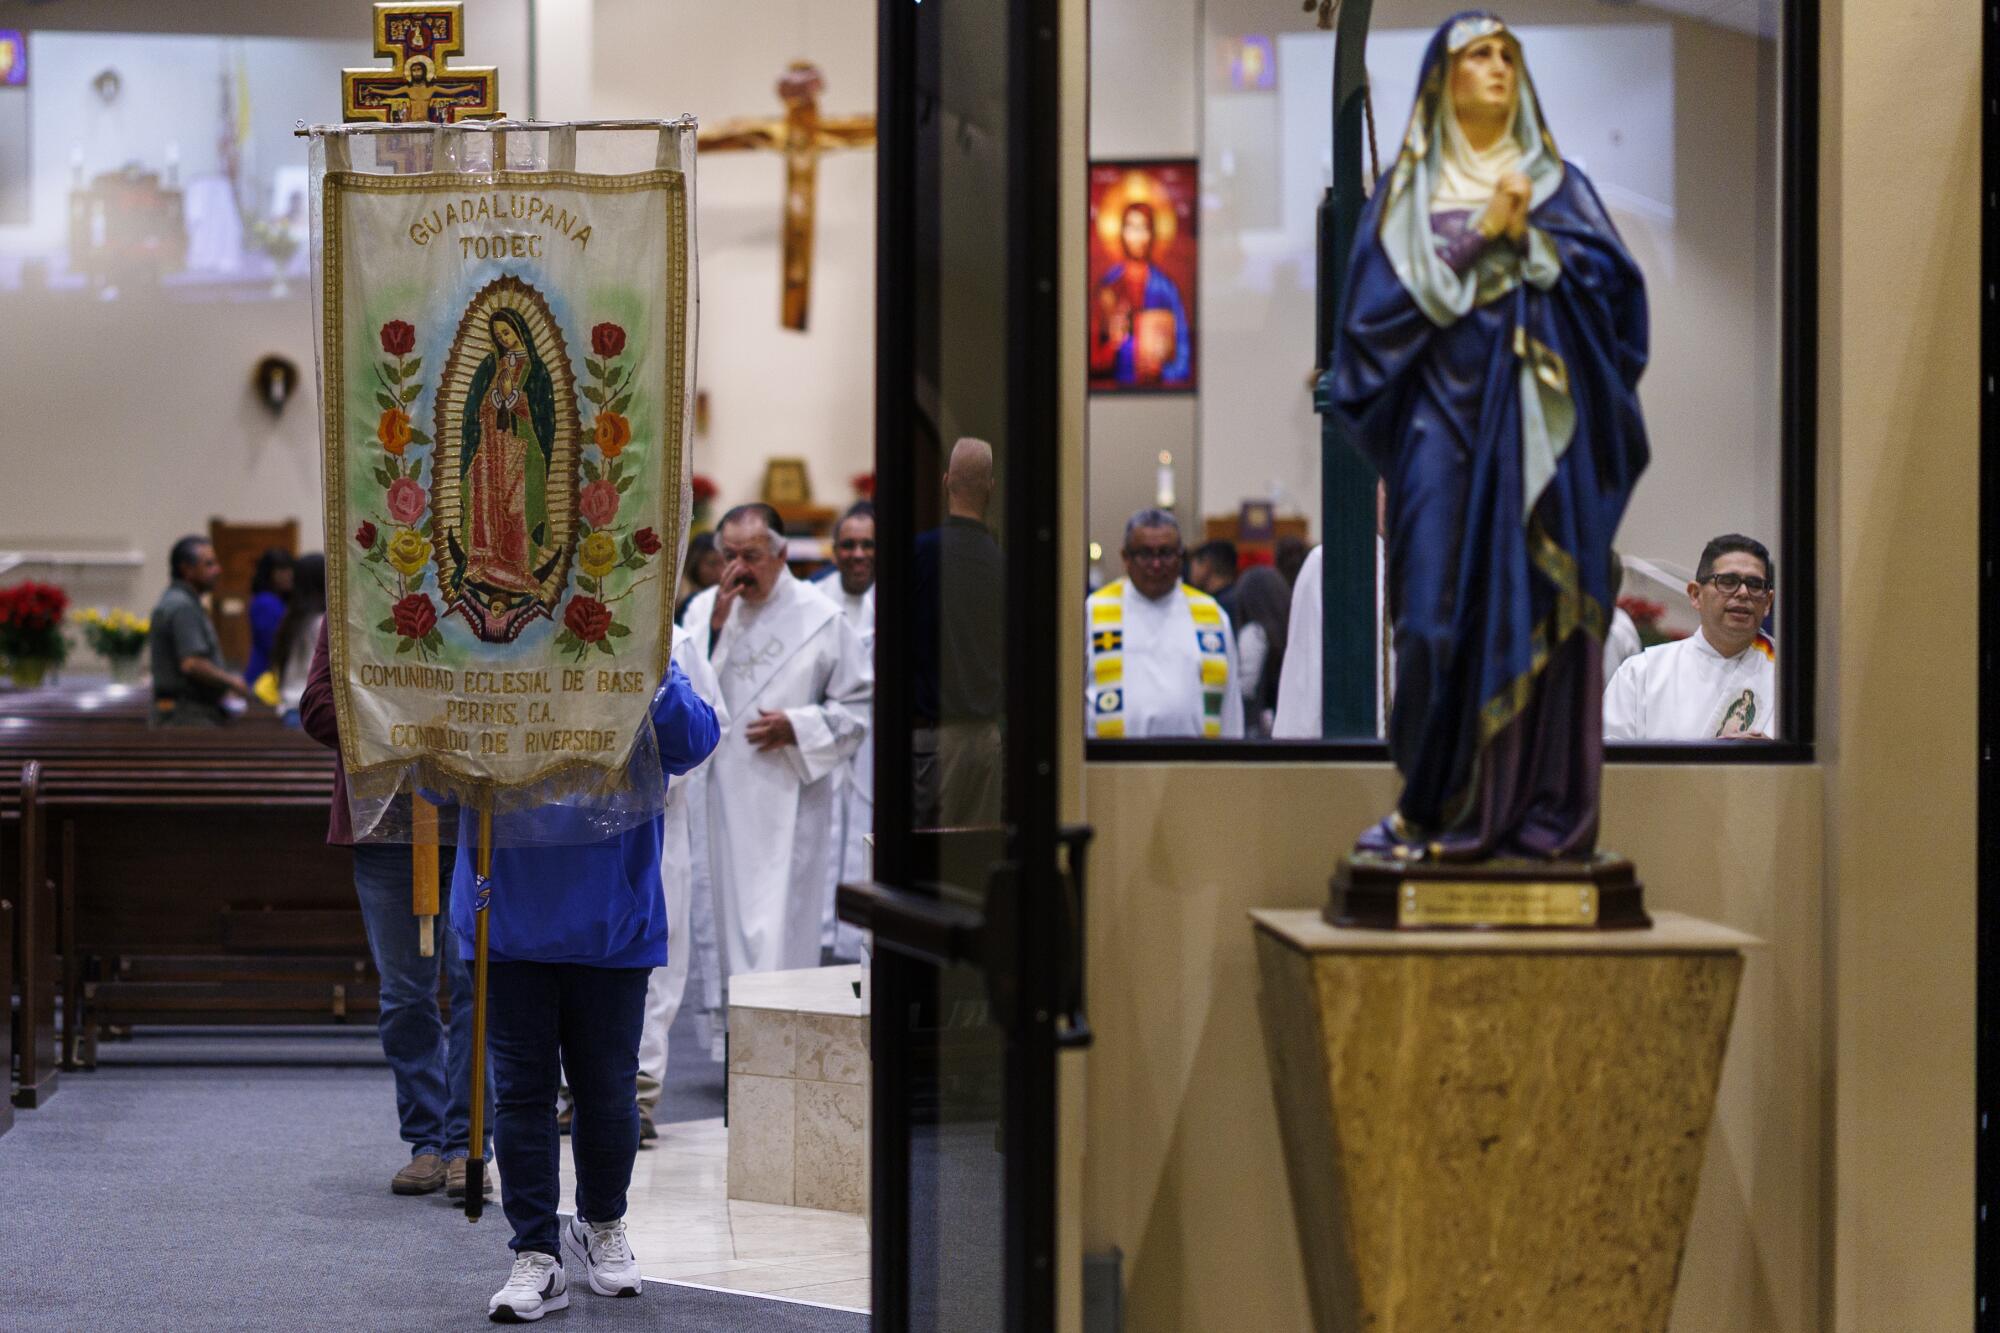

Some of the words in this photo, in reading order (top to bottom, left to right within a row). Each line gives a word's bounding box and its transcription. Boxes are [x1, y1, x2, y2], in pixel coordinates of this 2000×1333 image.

[409, 194, 592, 250] GUADALUPANA
[458, 235, 542, 259] TODEC
[361, 664, 454, 693] COMUNIDAD
[562, 670, 584, 692] DE
[597, 671, 644, 693] BASE
[446, 699, 518, 727] PERRIS,
[480, 732, 508, 754] DE
[525, 730, 616, 752] RIVERSIDE
